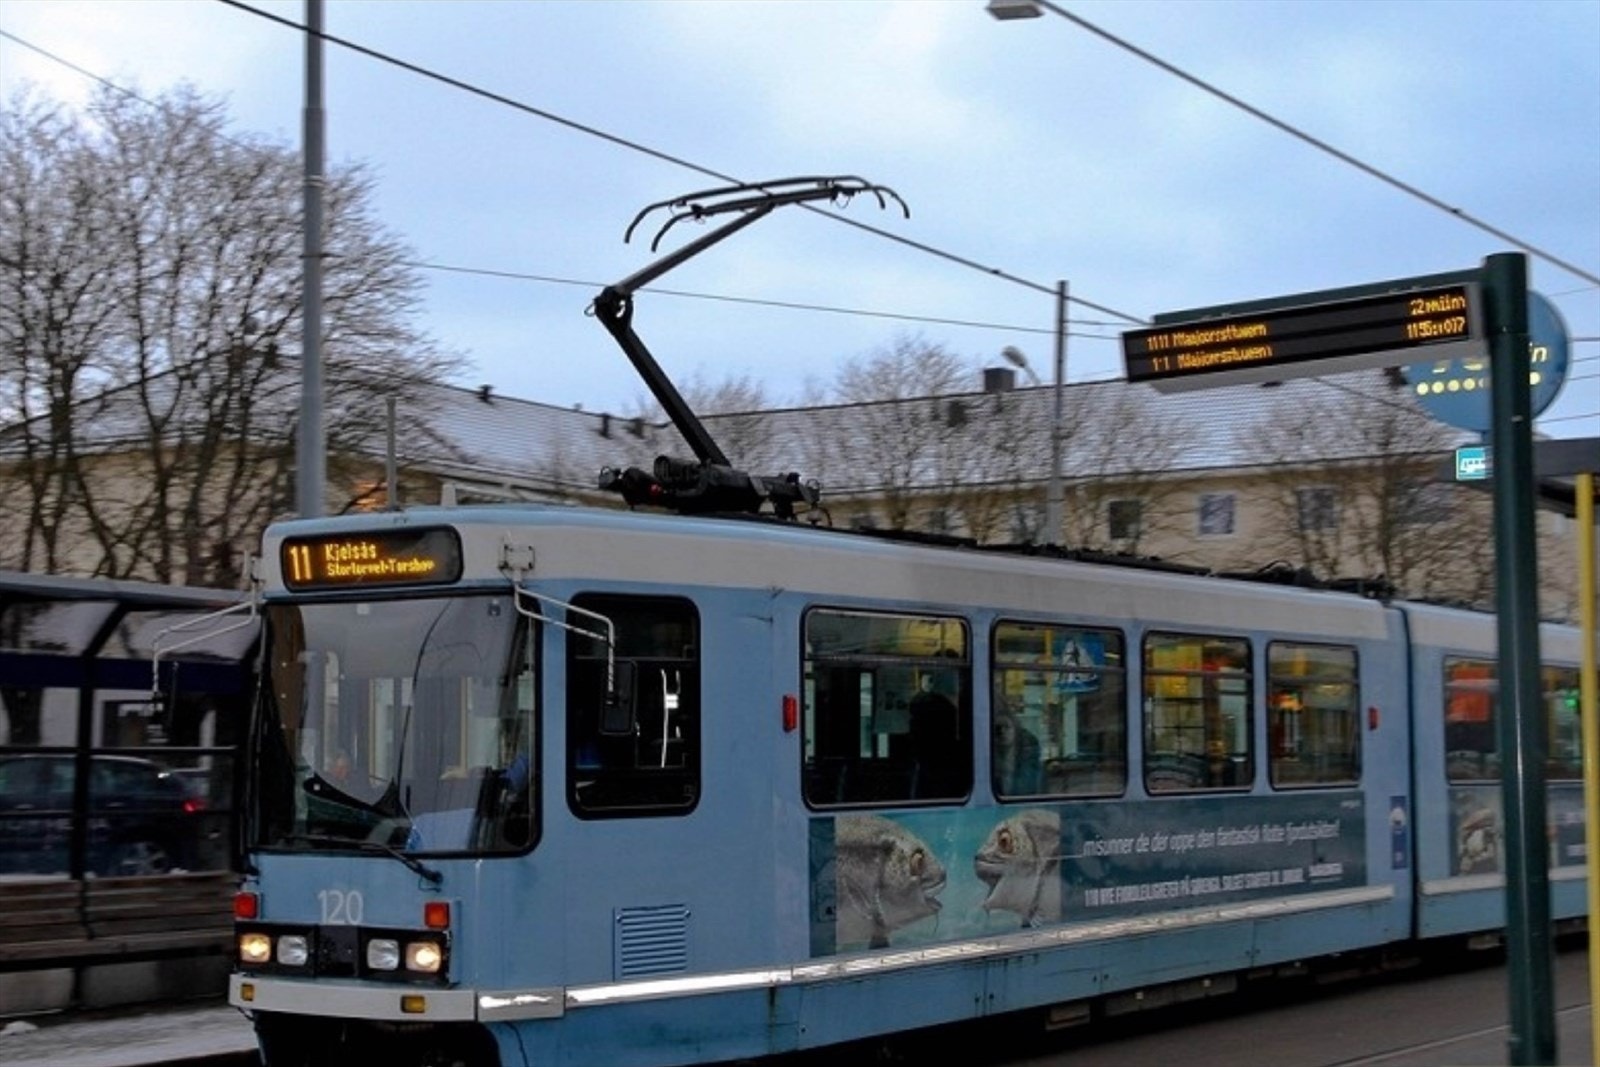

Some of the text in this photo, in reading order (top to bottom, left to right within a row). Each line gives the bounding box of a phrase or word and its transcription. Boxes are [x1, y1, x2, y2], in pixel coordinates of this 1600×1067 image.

[289, 545, 312, 581] 11
[325, 542, 377, 561] Kjelsås
[318, 889, 364, 926] 120
